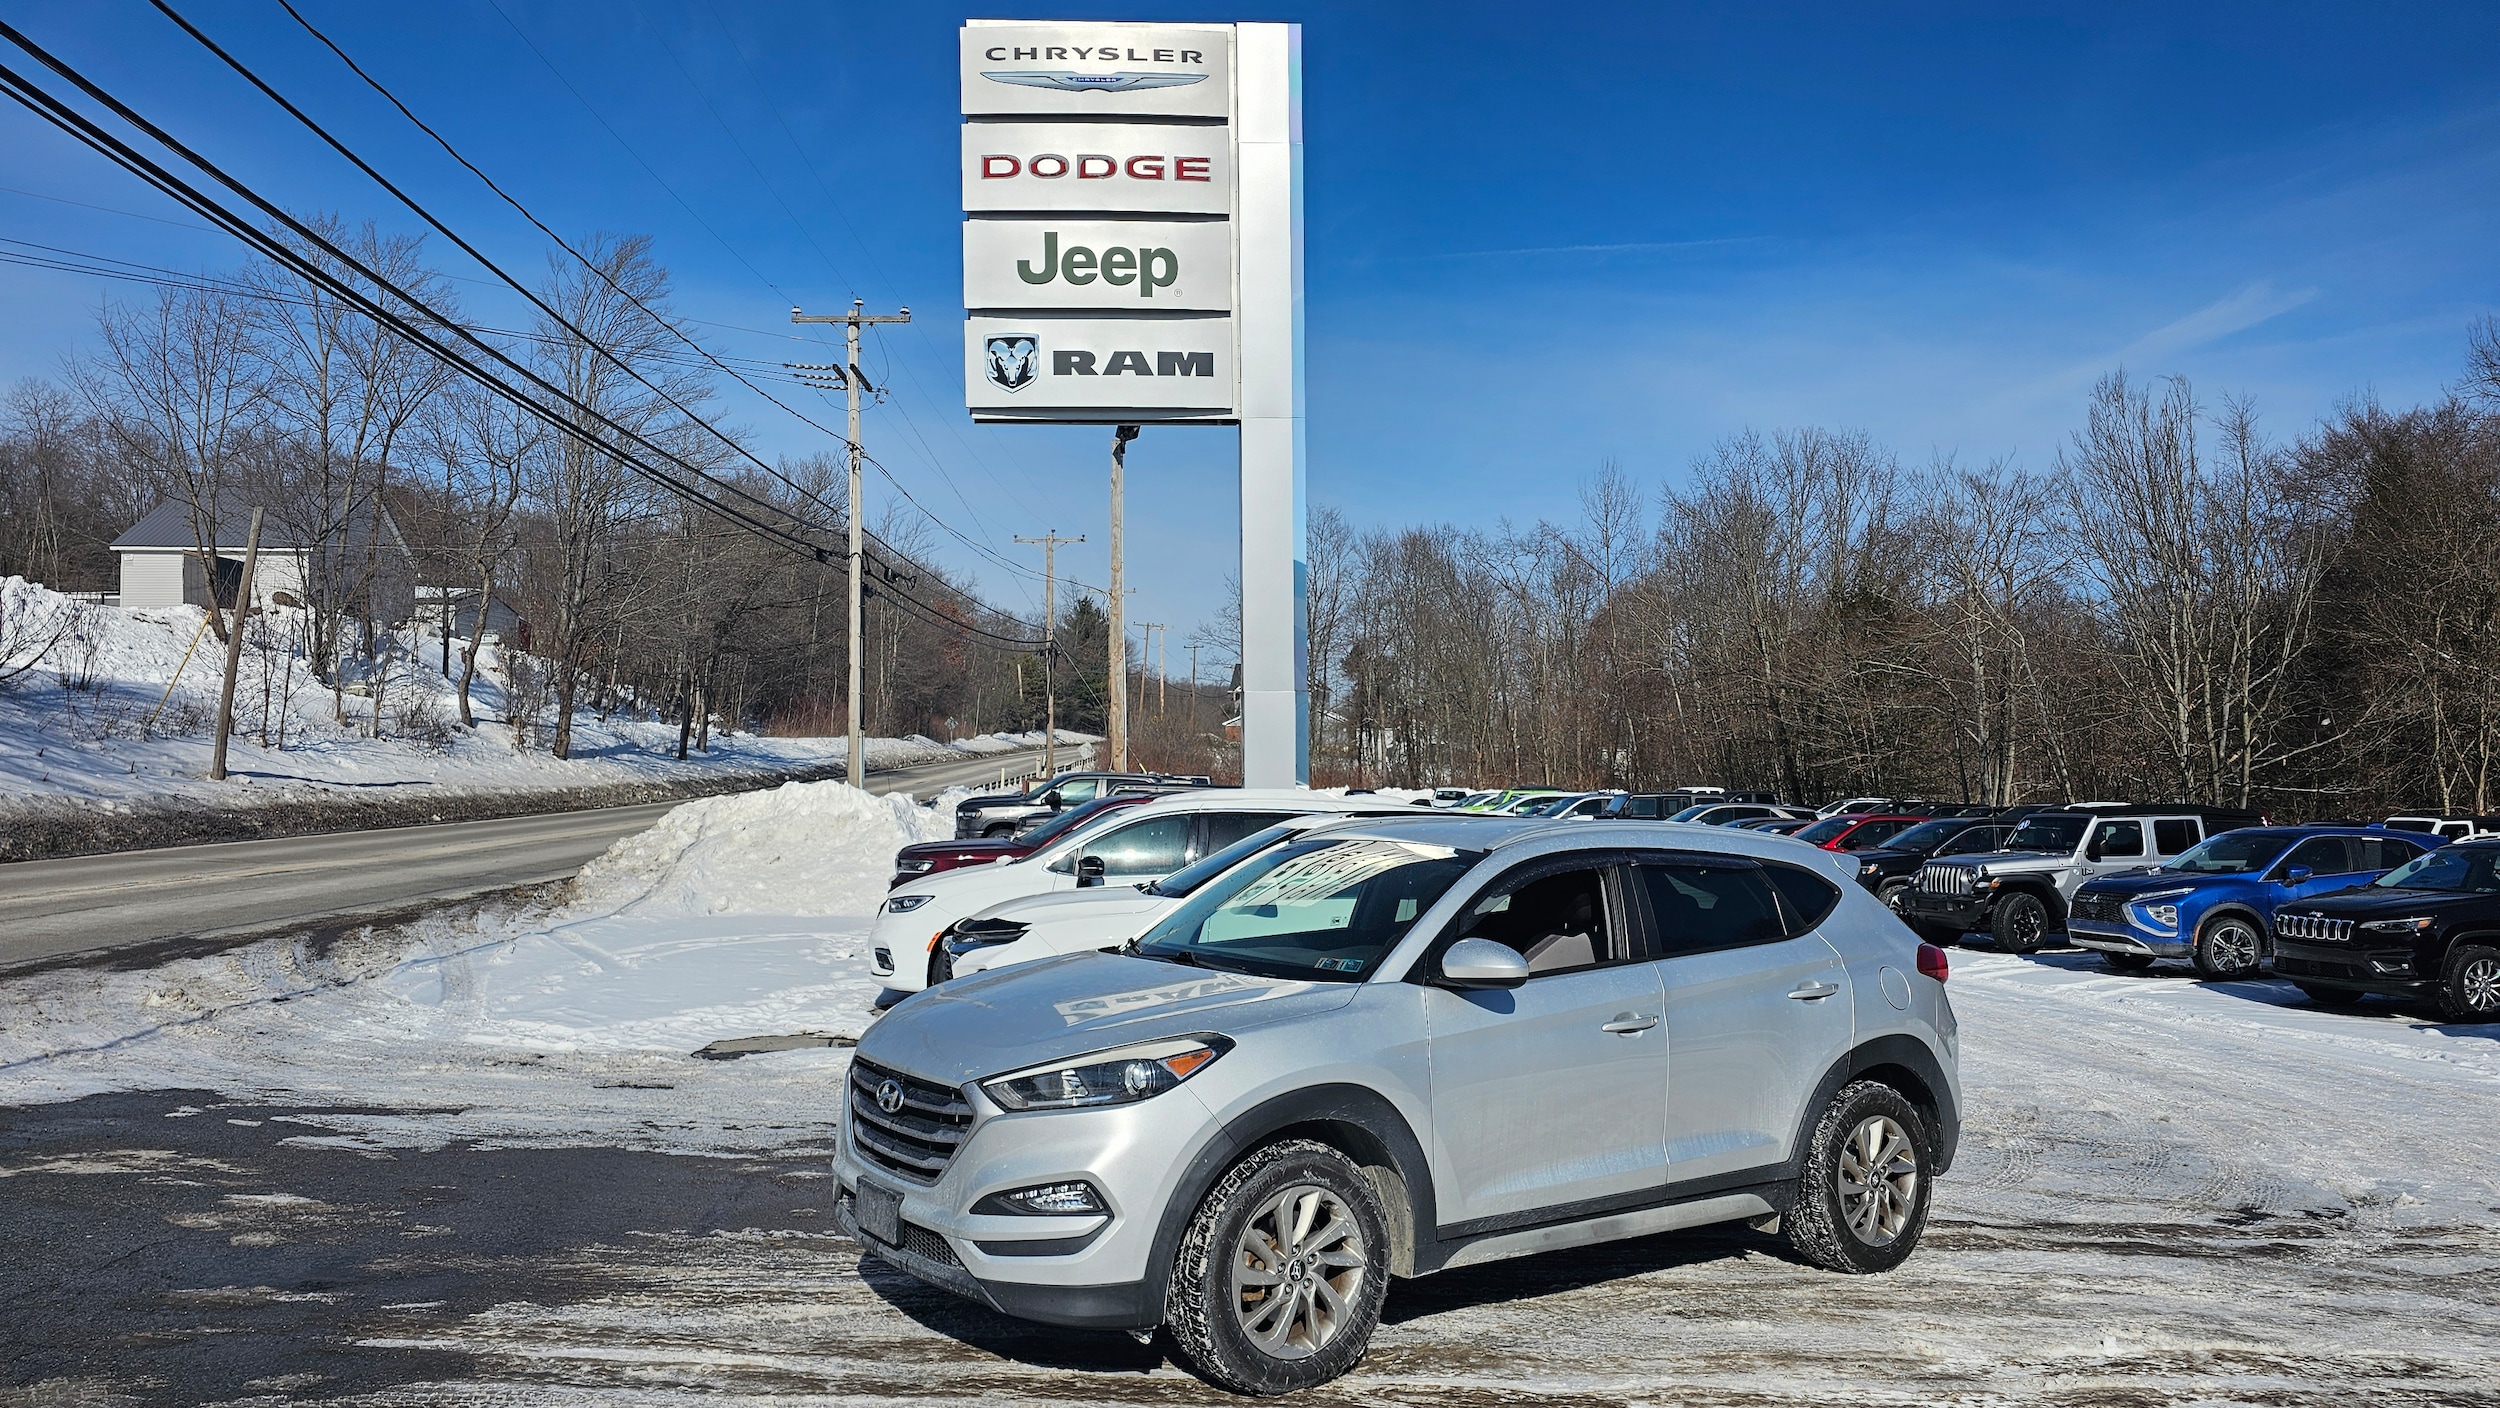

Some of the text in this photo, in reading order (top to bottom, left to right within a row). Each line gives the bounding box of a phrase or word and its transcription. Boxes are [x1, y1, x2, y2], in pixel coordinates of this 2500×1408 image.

[985, 46, 1203, 64] CHRYSLER
[980, 153, 1212, 183] DODGE
[1016, 231, 1179, 298] Jeep
[1053, 350, 1214, 377] RAM
